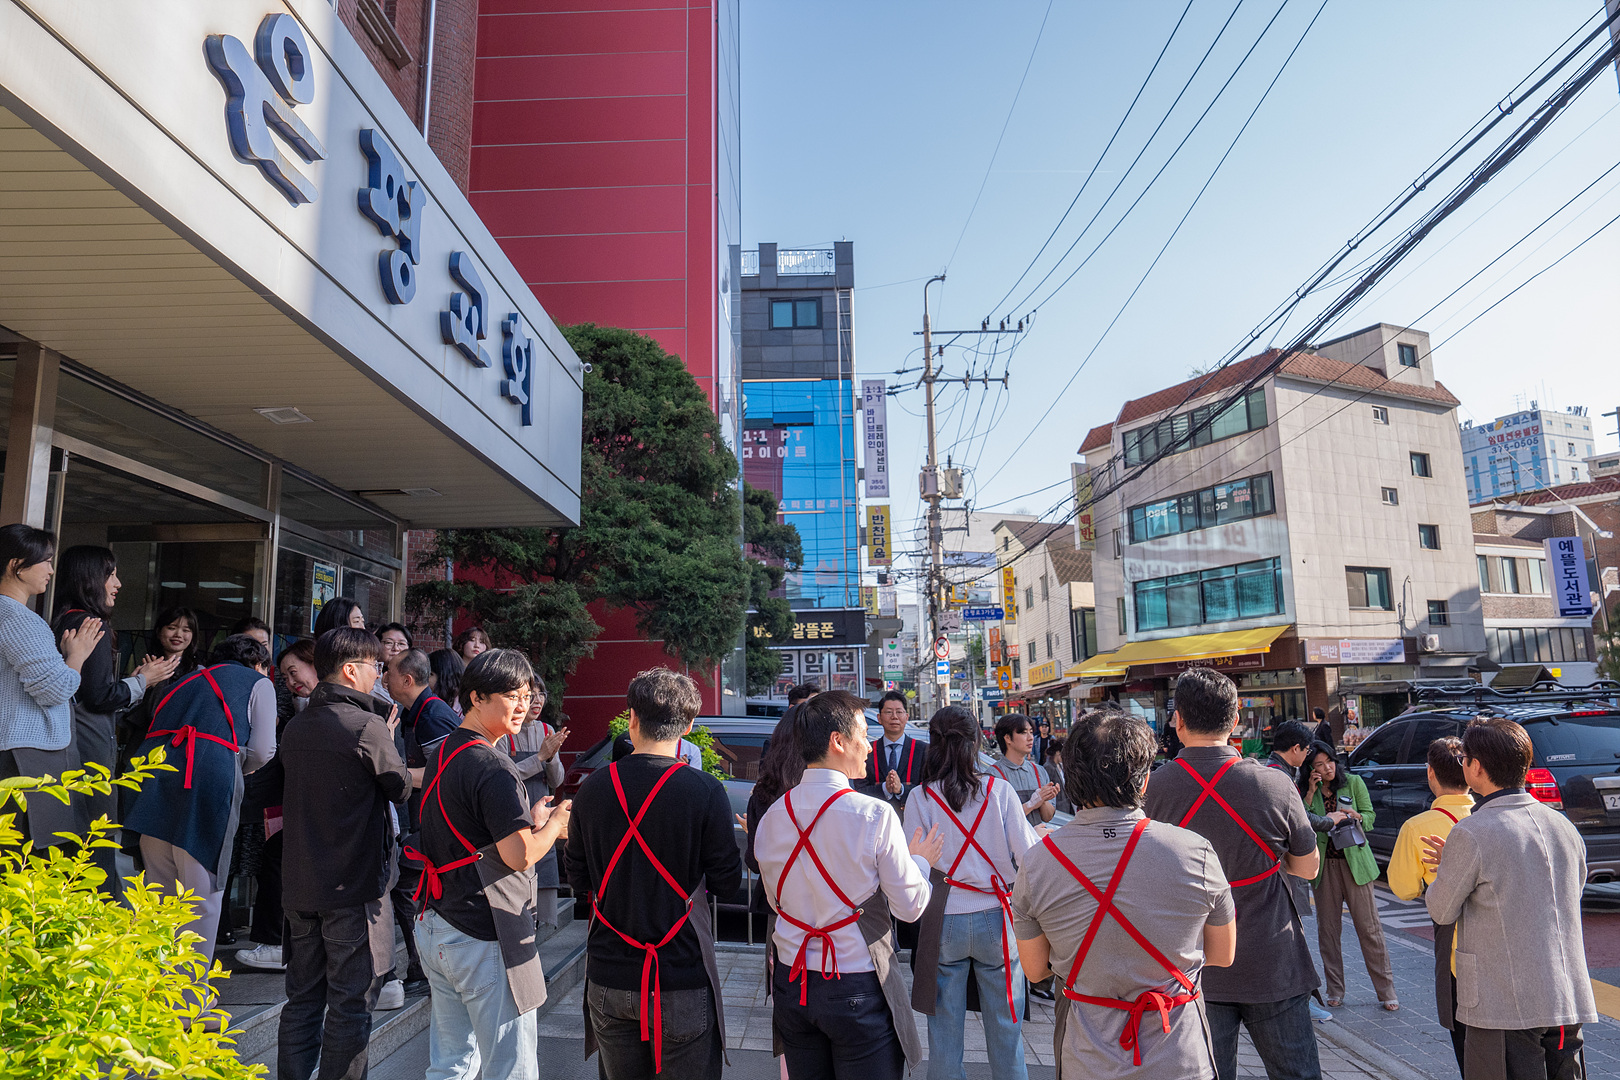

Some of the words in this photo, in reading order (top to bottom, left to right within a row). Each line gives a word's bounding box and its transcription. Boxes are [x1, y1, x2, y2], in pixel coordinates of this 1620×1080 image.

[202, 13, 535, 427] 은평교회
[866, 386, 882, 394] 1:1
[866, 394, 882, 402] PT
[743, 430, 768, 442] 1:1
[867, 408, 876, 449] 바디브레인
[1491, 437, 1539, 455] 375-0505
[871, 514, 886, 559] 반찬다움
[1558, 539, 1583, 607] 예뜰도서관
[792, 622, 835, 639] 알뜰폰
[1320, 645, 1338, 659] 백반
[1610, 796, 1620, 808] 2
[1103, 828, 1117, 839] 55
